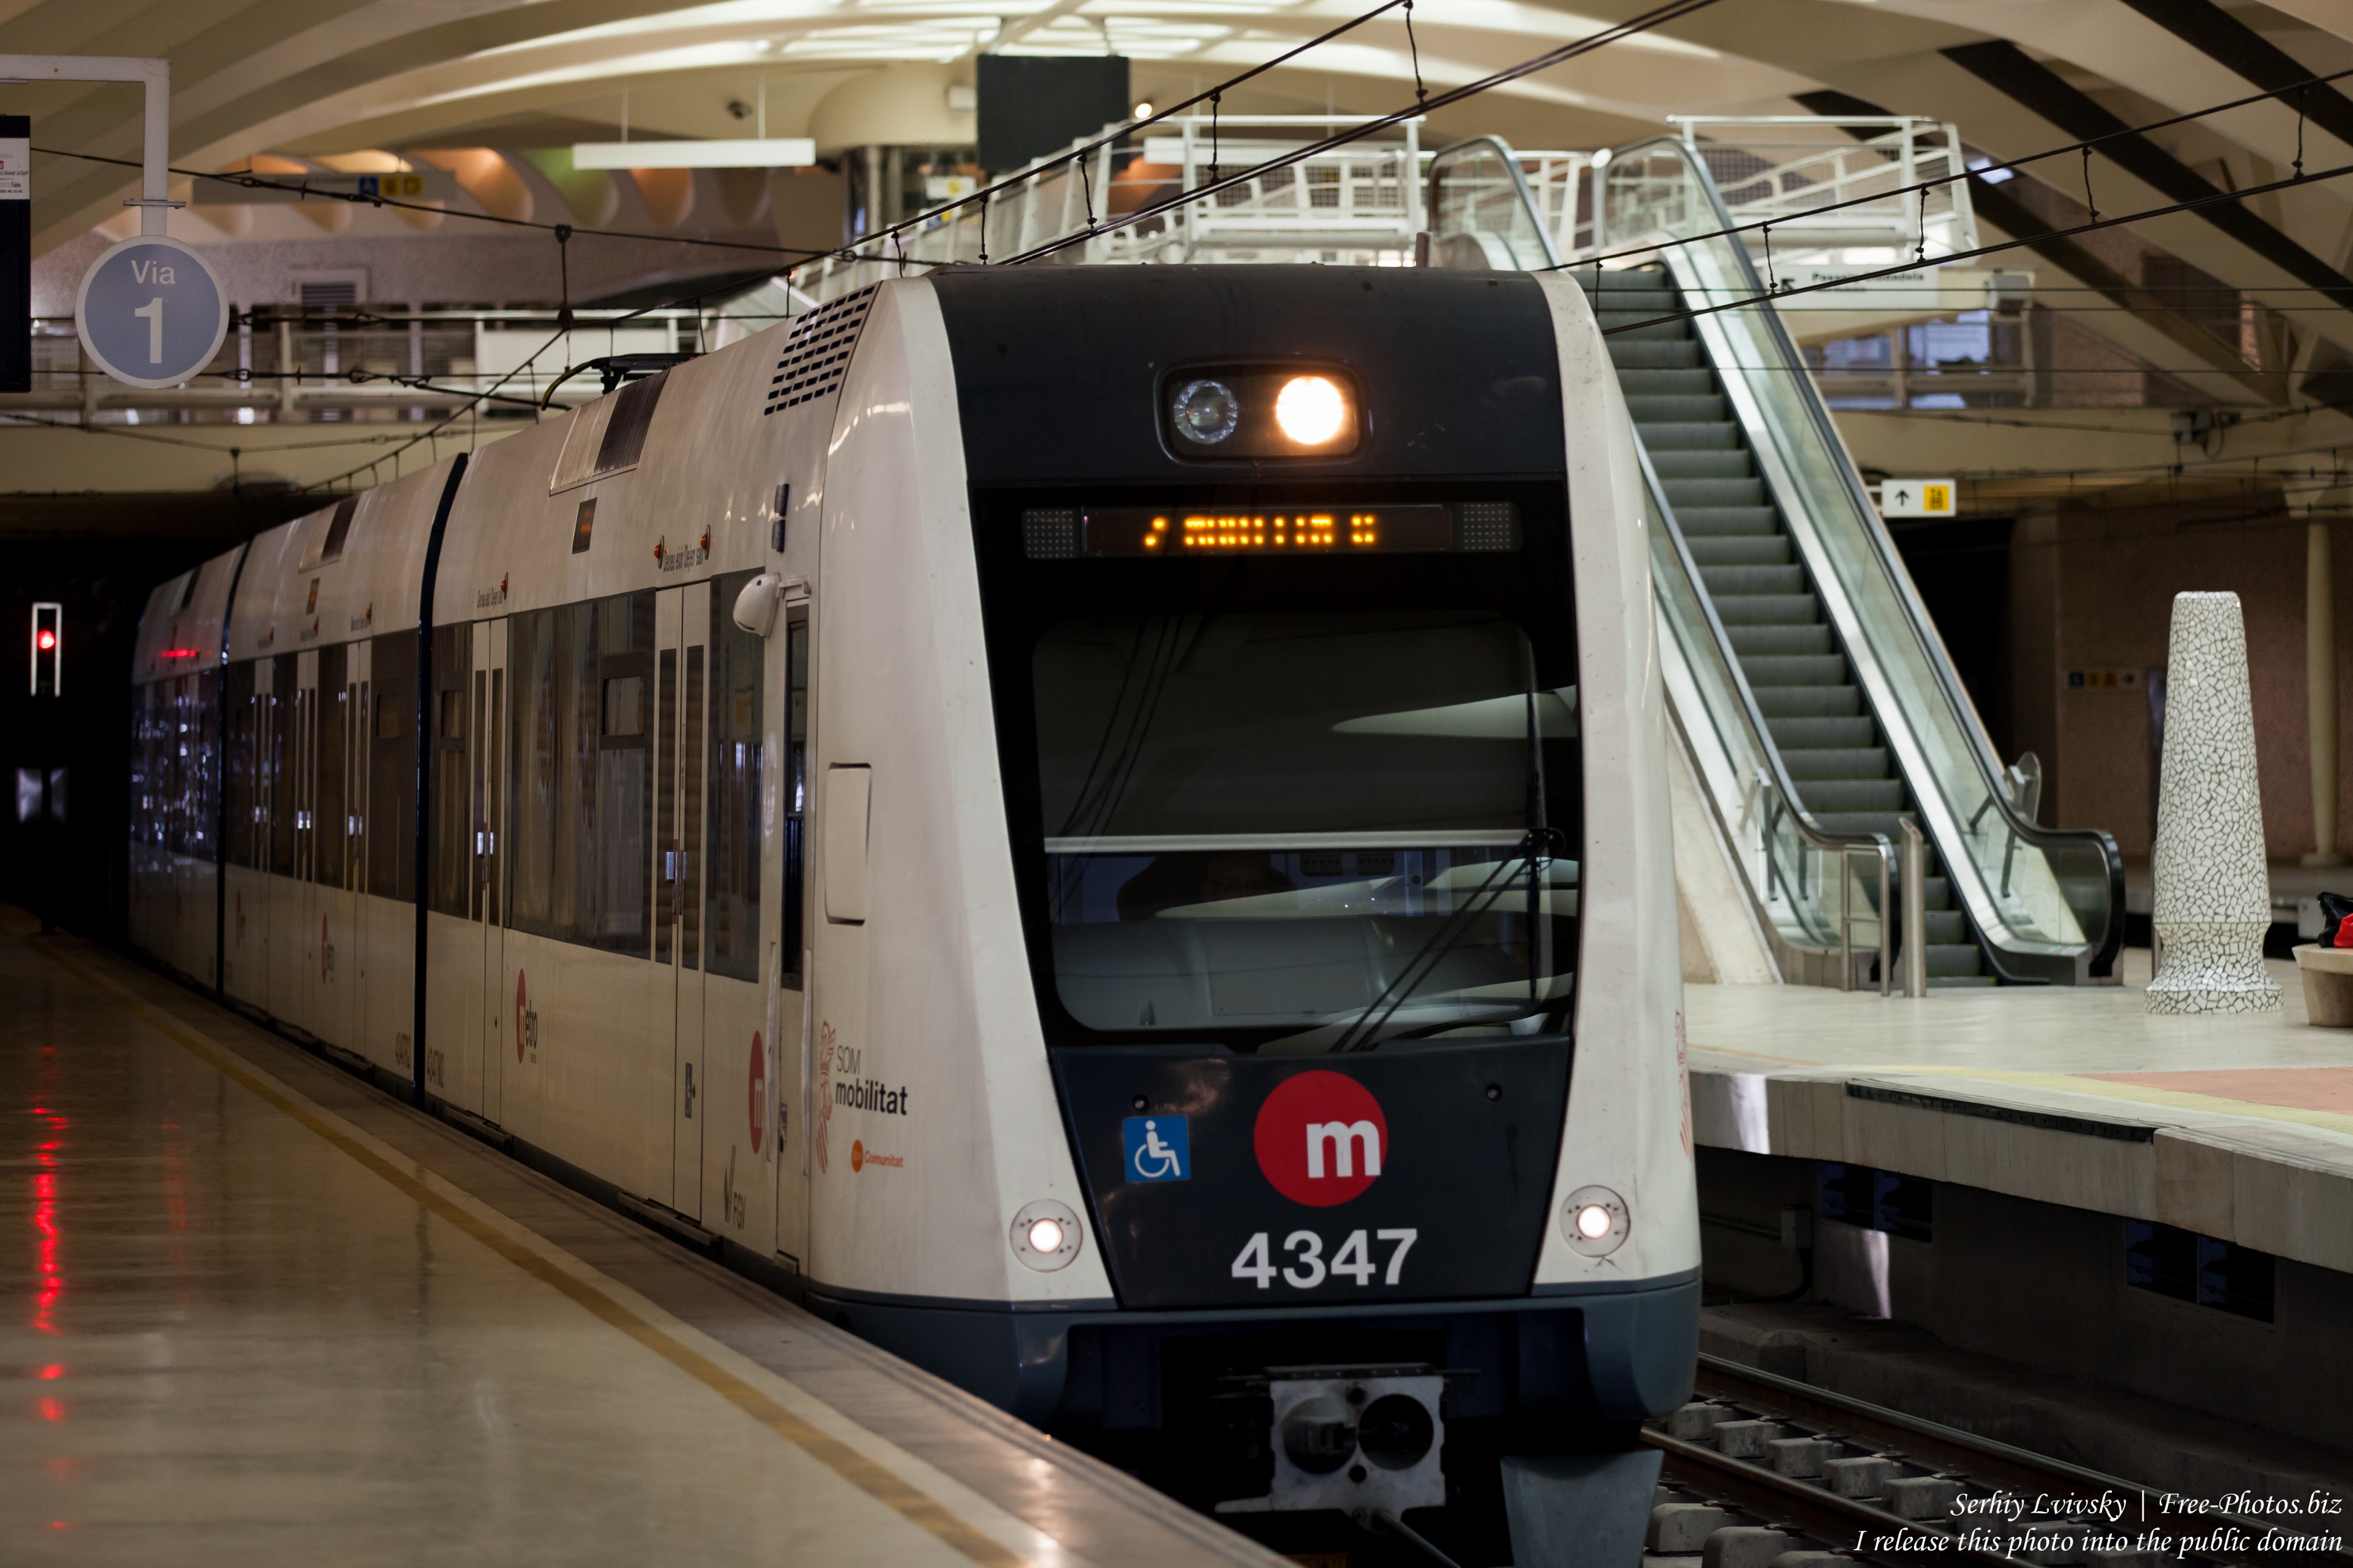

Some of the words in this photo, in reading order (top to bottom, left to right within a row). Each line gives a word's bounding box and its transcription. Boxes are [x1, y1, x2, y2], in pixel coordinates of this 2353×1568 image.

[131, 259, 176, 285] Via
[134, 297, 163, 365] 1
[836, 1045, 861, 1075] SOM
[835, 1078, 908, 1116] mobilitat
[865, 1149, 904, 1169] Comunitat
[1305, 1120, 1381, 1179] m
[733, 1192, 746, 1230] FGV
[1231, 1228, 1418, 1289] 4347
